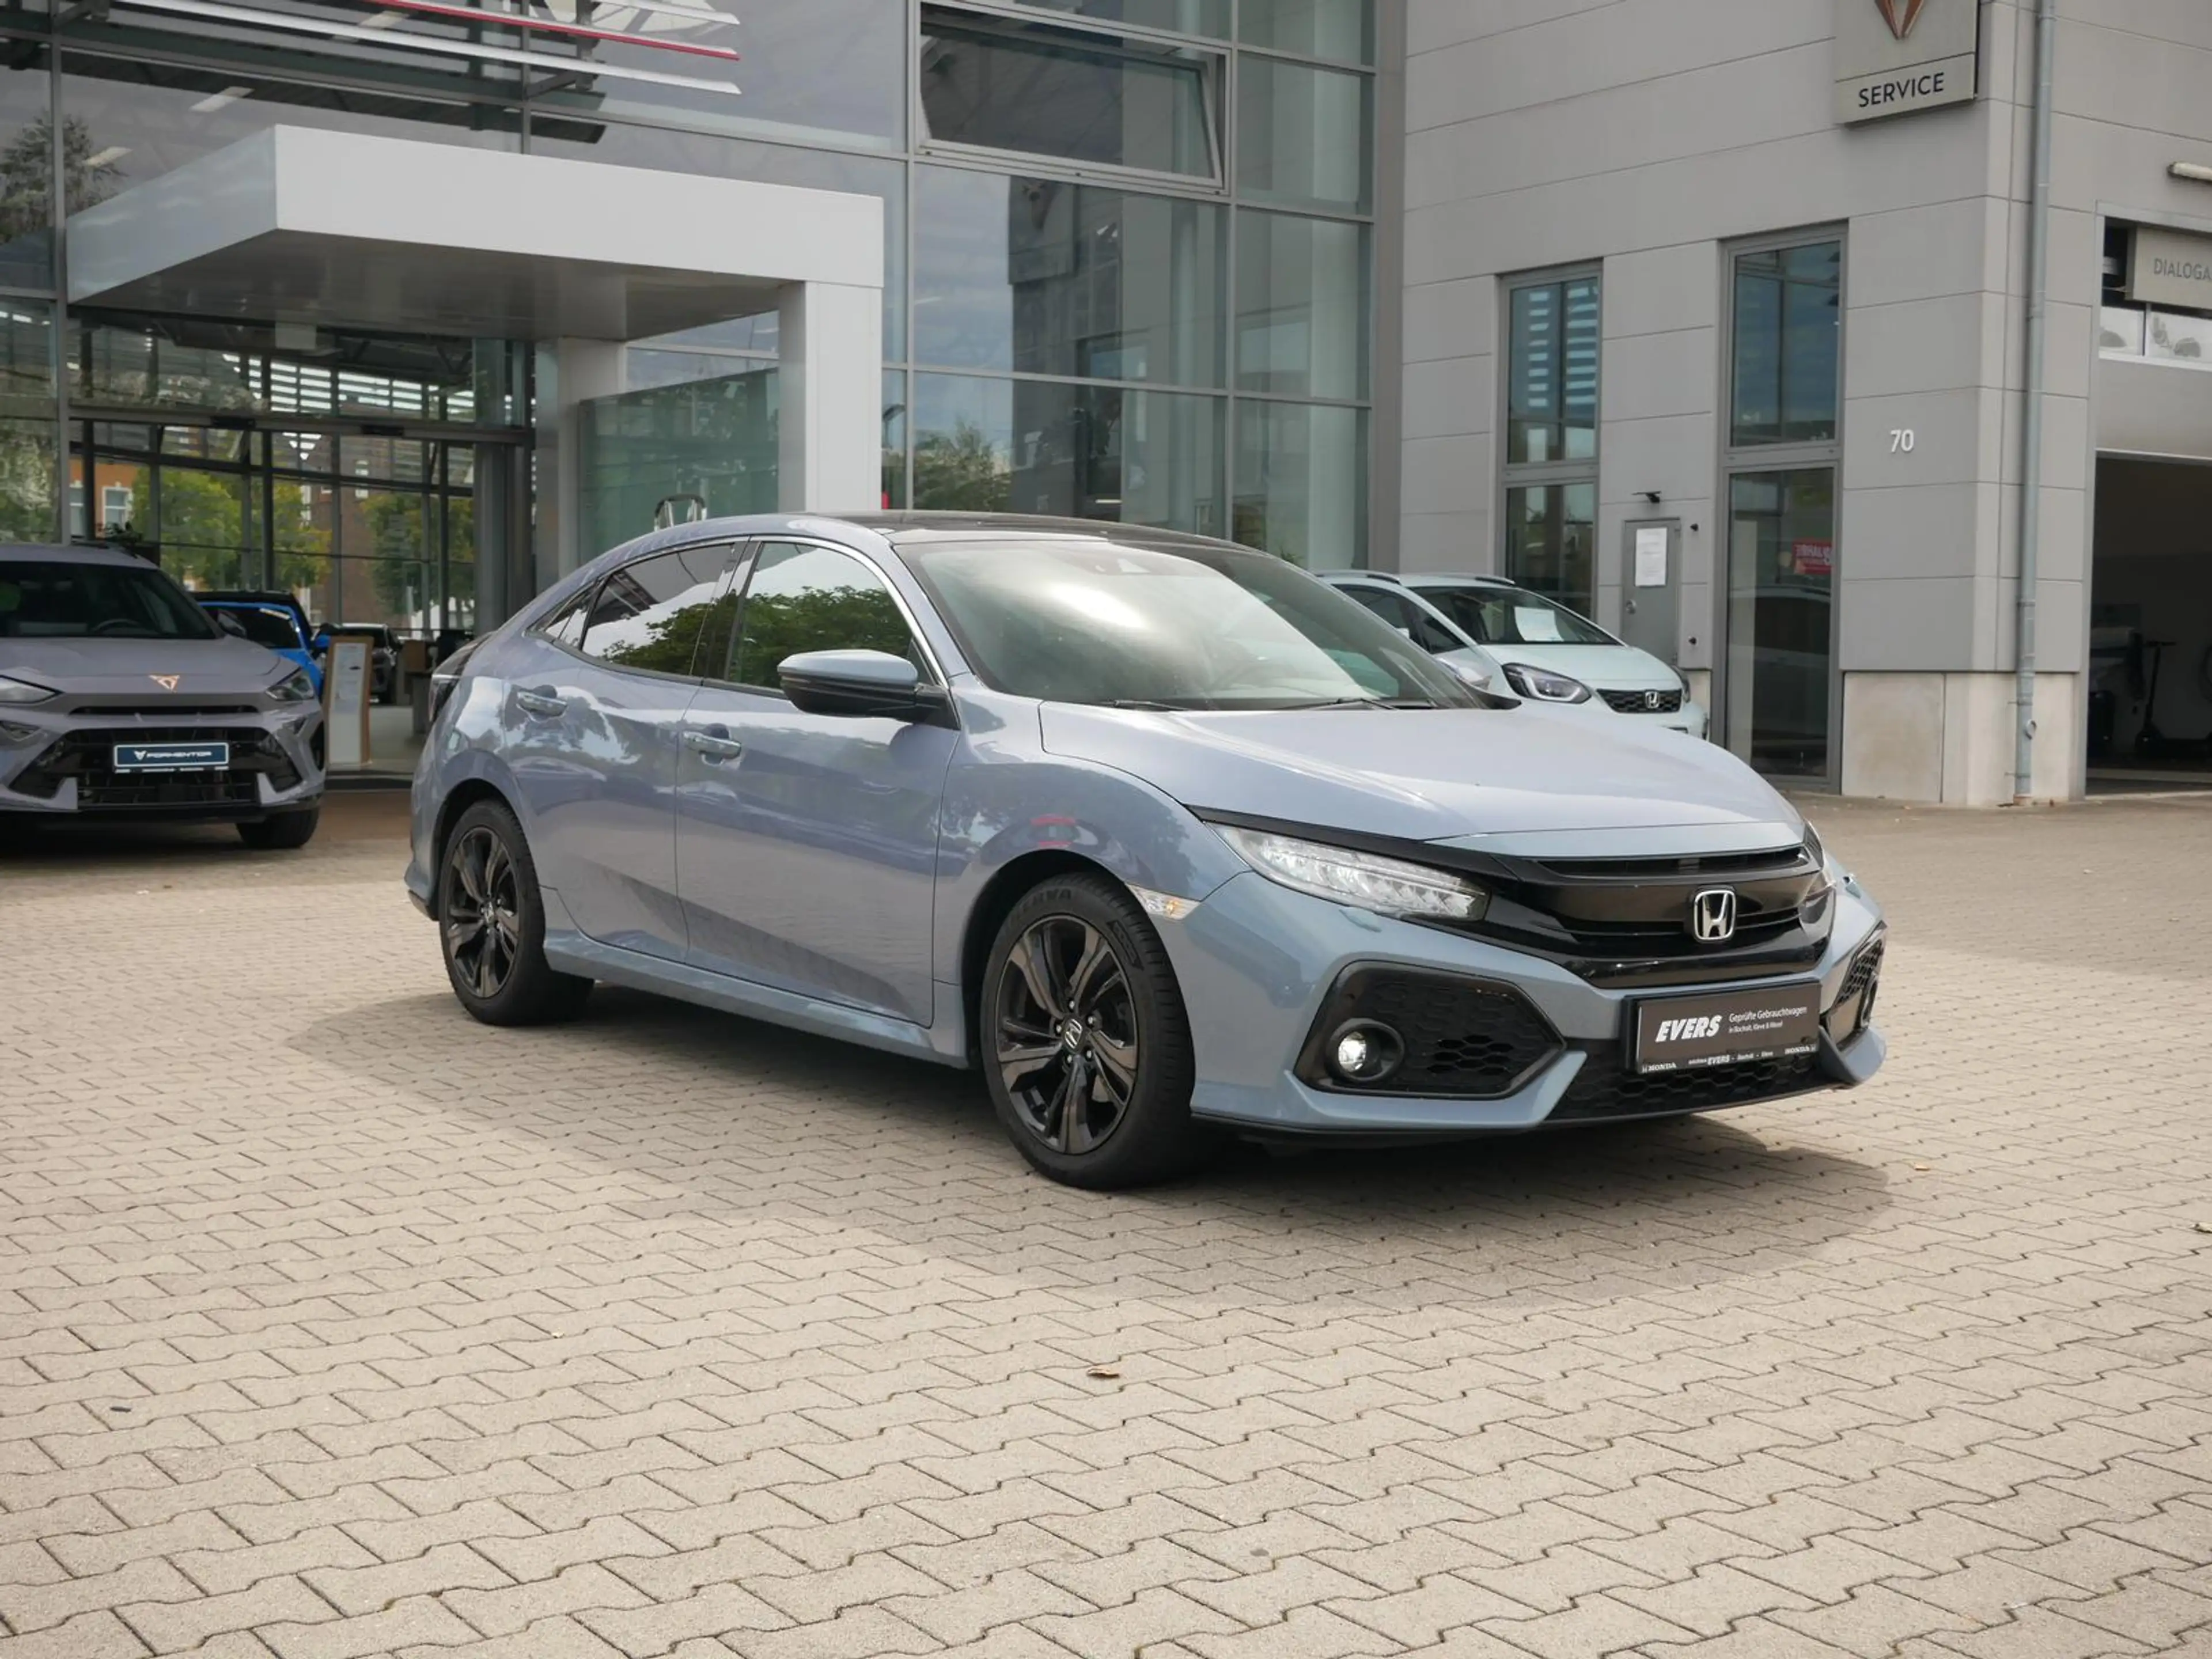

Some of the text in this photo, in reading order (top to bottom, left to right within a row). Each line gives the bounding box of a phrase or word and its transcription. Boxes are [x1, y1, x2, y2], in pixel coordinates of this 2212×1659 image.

[1859, 72, 1945, 108] SERVICE
[1890, 429, 1915, 453] 70
[1655, 1014, 1722, 1043] EVERS
[1729, 1012, 1757, 1024] Geprüfte
